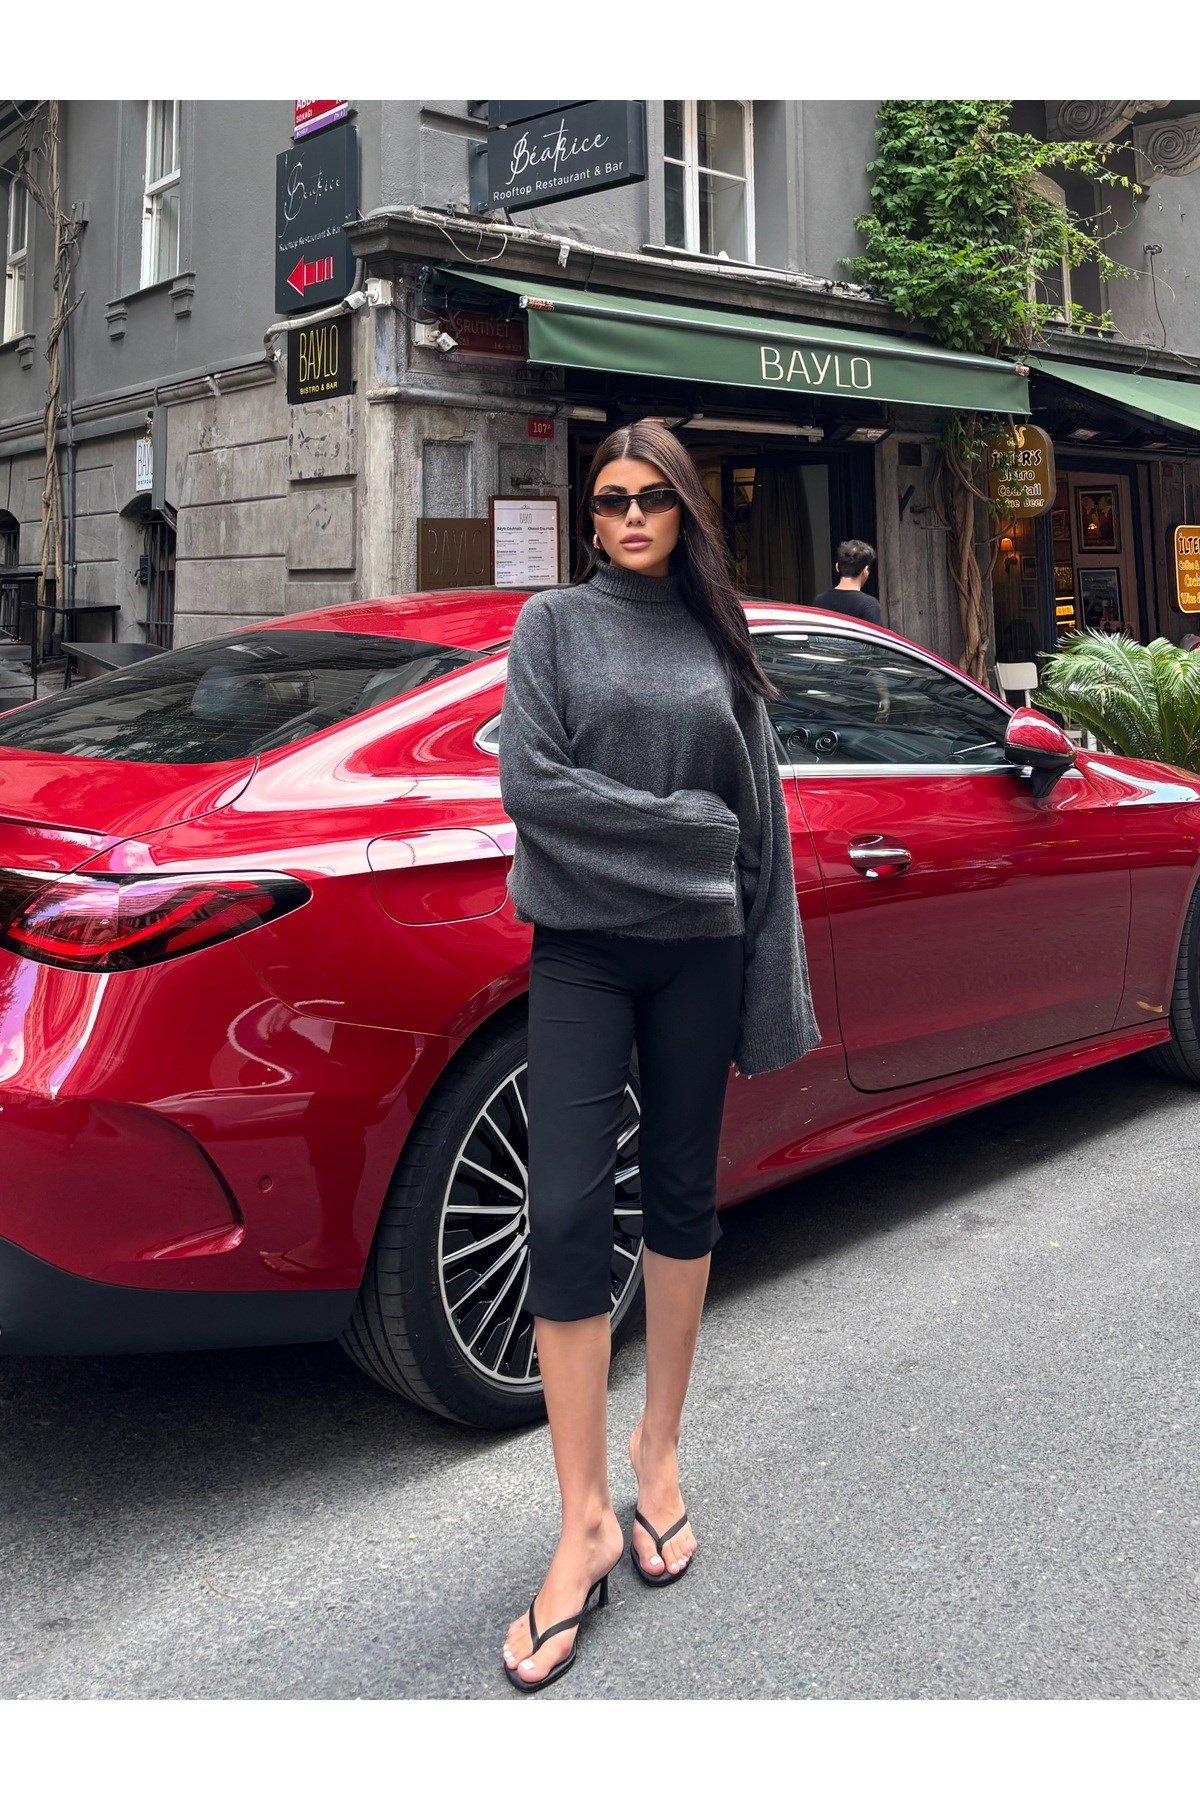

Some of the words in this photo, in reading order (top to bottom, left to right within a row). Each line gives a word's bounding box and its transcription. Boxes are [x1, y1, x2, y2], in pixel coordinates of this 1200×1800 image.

[505, 118, 610, 185] Béatrice
[493, 184, 532, 201] Rooftop
[535, 169, 590, 191] Restaurant
[594, 165, 602, 176] &
[605, 161, 624, 174] Bar
[299, 324, 339, 383] BAYLO
[760, 346, 872, 389] BAYLO
[300, 385, 320, 395] BISTRO
[326, 381, 338, 389] BAR
[1178, 533, 1200, 555] İLTE
